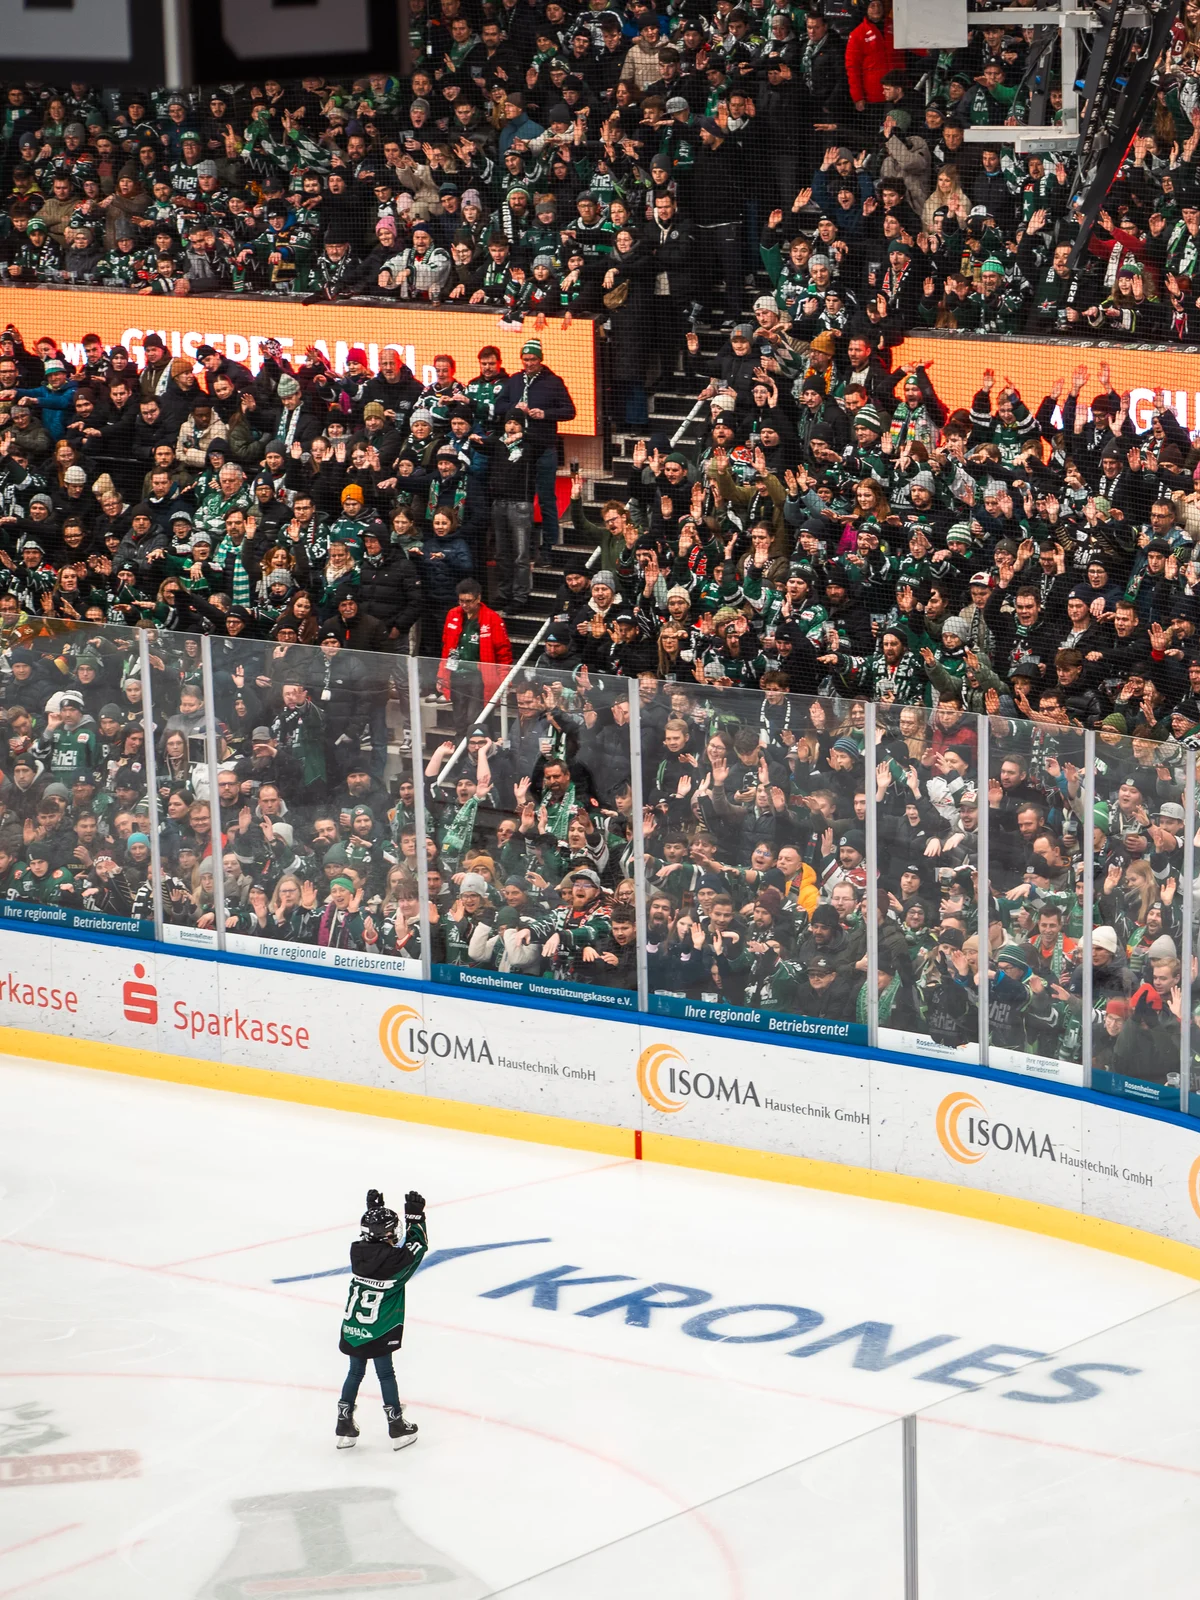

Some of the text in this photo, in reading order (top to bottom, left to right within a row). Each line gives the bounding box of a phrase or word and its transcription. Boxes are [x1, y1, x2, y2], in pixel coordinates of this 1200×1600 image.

[4, 906, 140, 932] Ihre regionale Betriebsrente!
[259, 944, 406, 972] Ihre regionale Betriebsrente!
[459, 972, 633, 1007] Rosenheimer Unterstützungskasse e.V.
[173, 1000, 310, 1051] Sparkasse
[684, 1004, 849, 1036] Ihre regionale Betriebsrente!
[409, 1027, 596, 1081] ISOMA Haustechnik GmbH
[669, 1067, 870, 1125] ISOMA Haustechnik GmbH
[969, 1117, 1153, 1187] ISOMA Haustechnik GmbH
[479, 1264, 1142, 1405] KRONES
